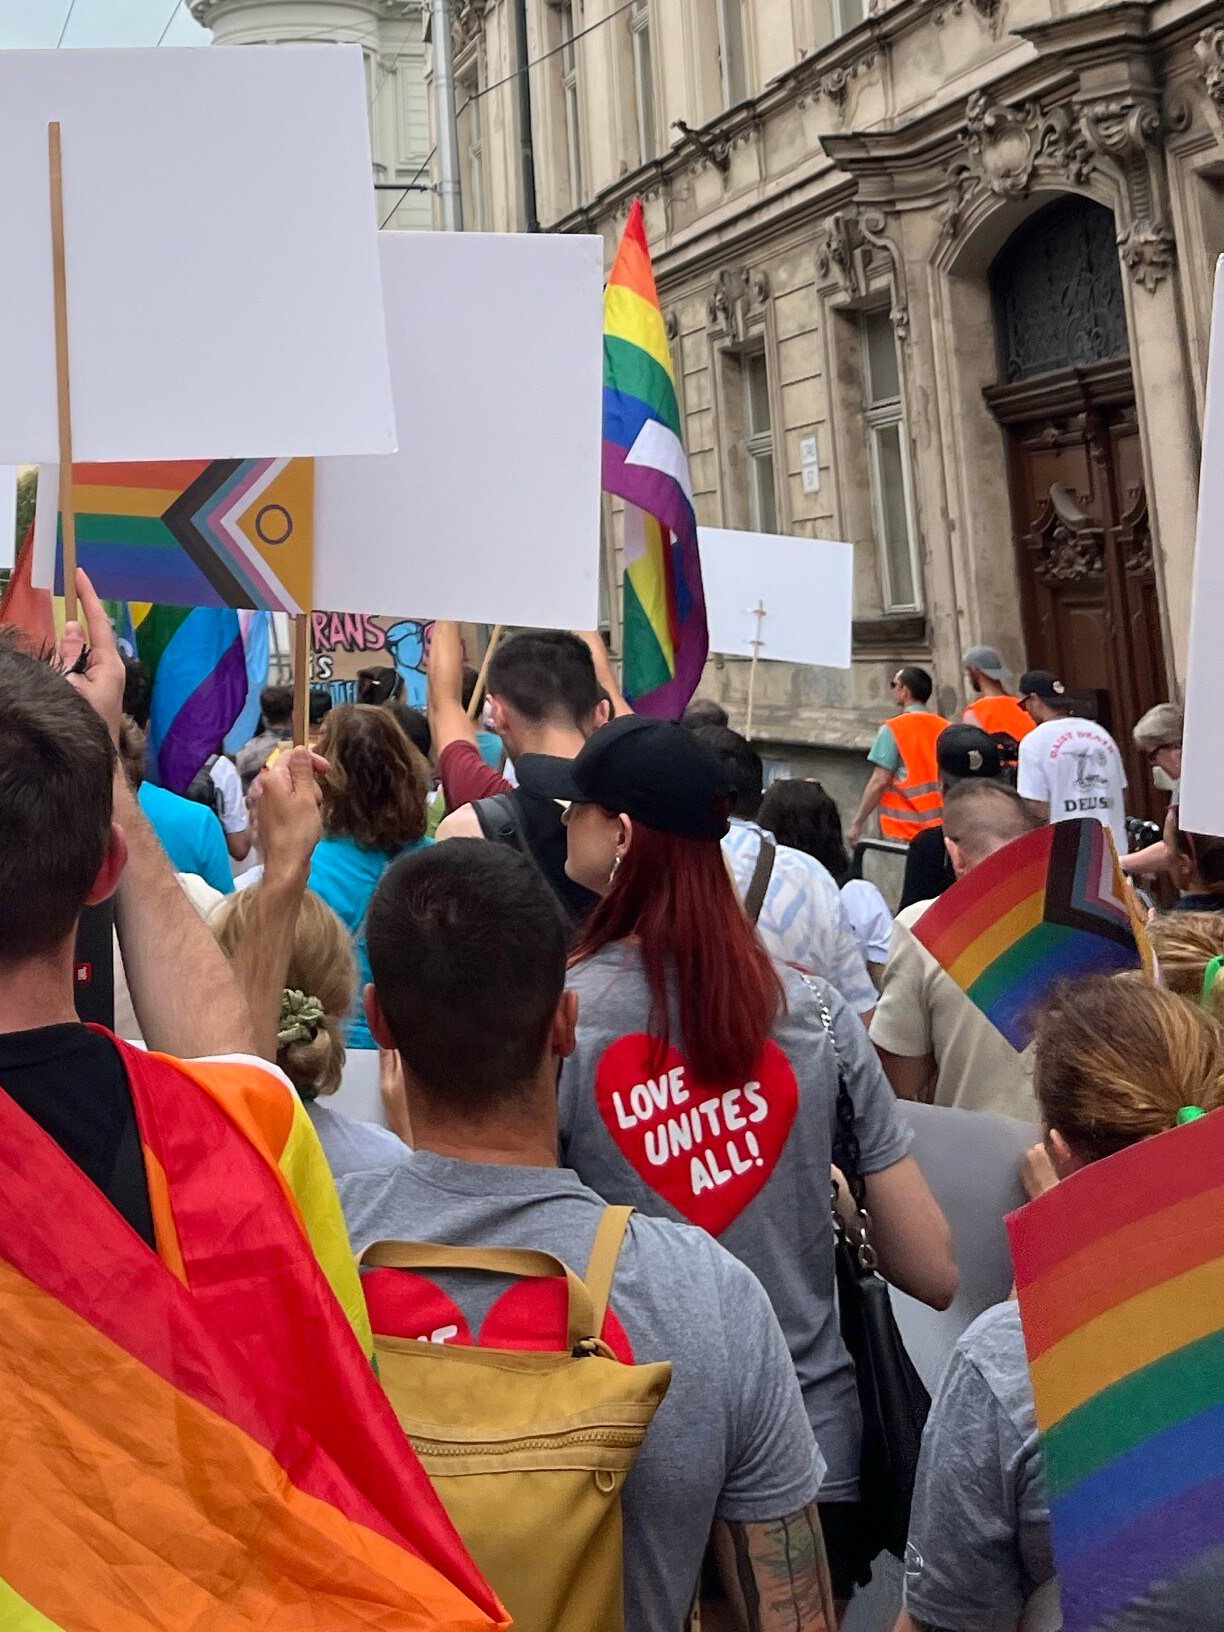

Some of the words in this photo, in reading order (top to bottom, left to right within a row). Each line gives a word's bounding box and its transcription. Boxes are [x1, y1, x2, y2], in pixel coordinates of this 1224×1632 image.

[289, 610, 387, 654] RANS
[612, 1066, 690, 1129] LOVE
[644, 1081, 768, 1165] UNITES
[690, 1131, 764, 1195] ALL!
